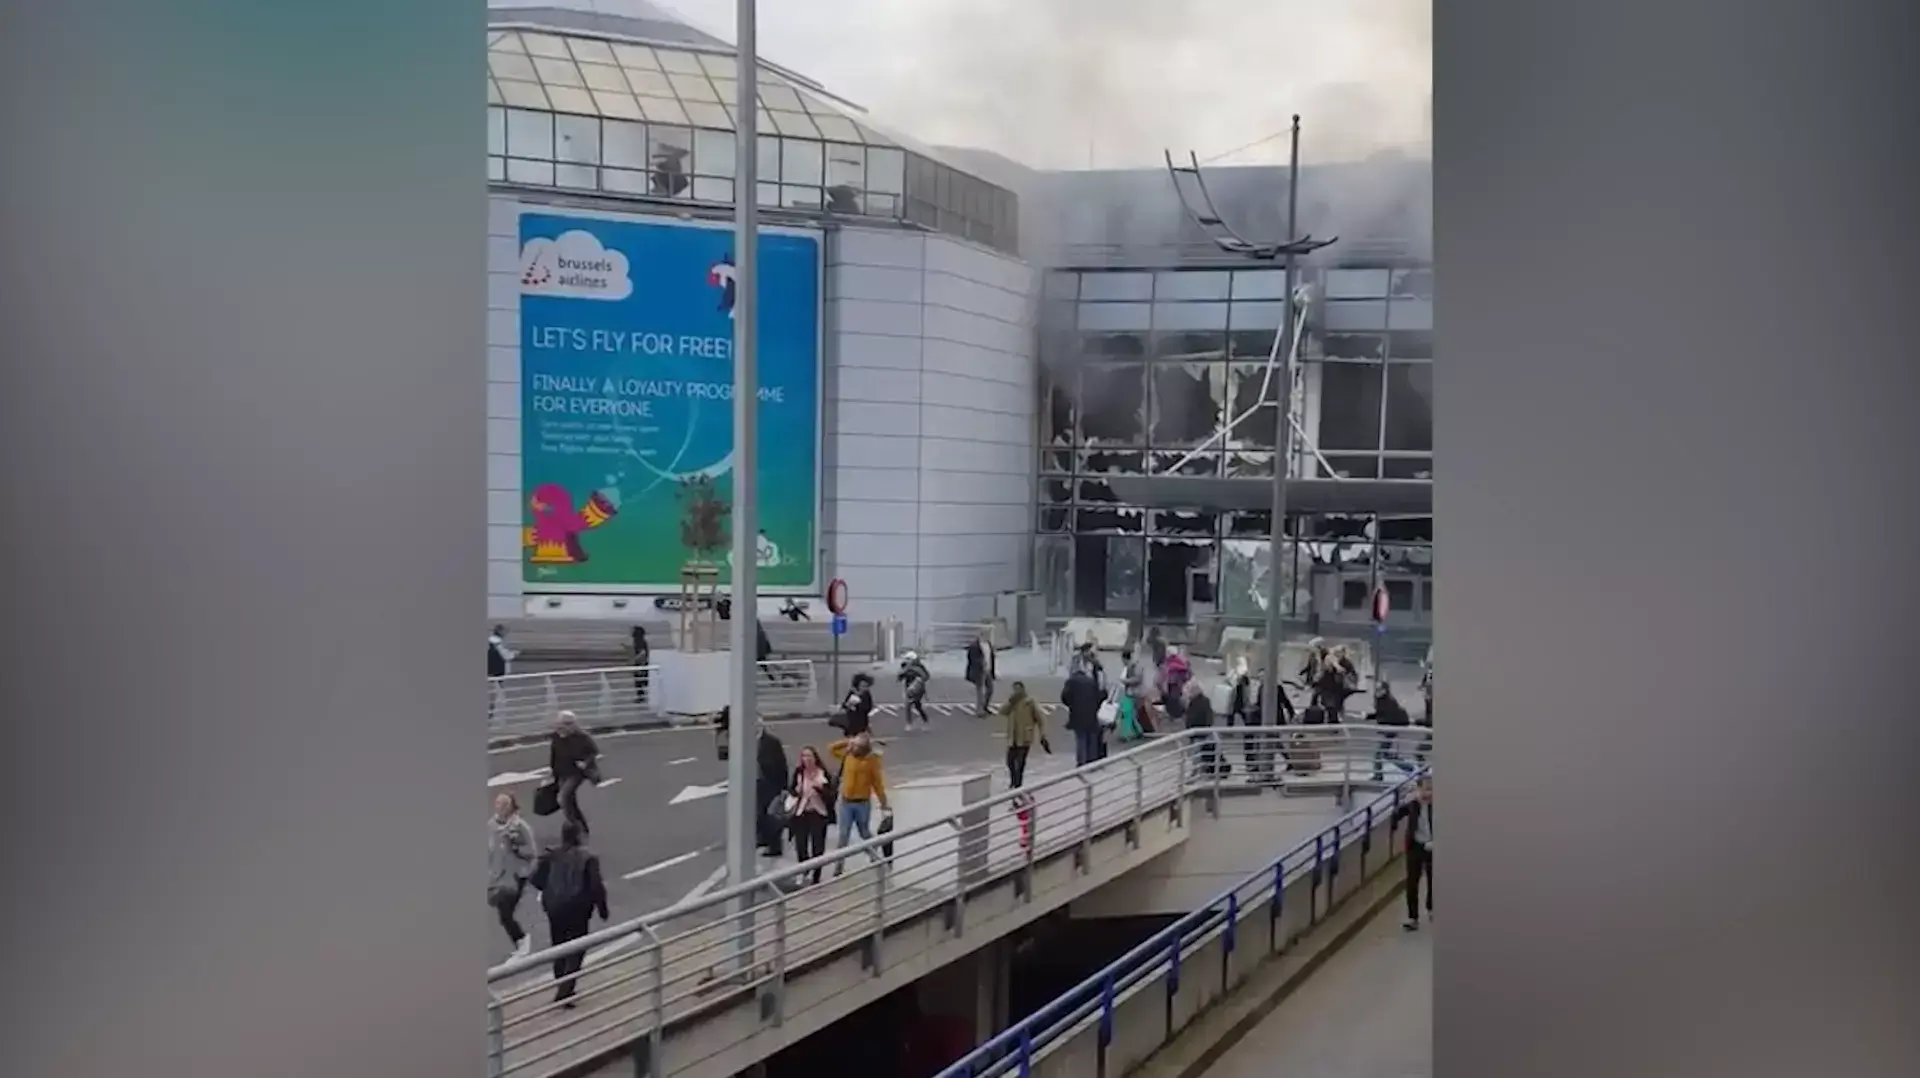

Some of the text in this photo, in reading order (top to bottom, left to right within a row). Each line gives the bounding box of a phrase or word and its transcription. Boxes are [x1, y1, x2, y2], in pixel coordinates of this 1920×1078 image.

[557, 255, 612, 272] brussels
[557, 274, 608, 288] airlines
[533, 326, 588, 350] LET'S
[593, 330, 625, 352] FLY
[632, 332, 673, 355] FOR
[602, 378, 615, 393] A
[619, 379, 683, 397] LOYALTY
[533, 396, 567, 413] FOR
